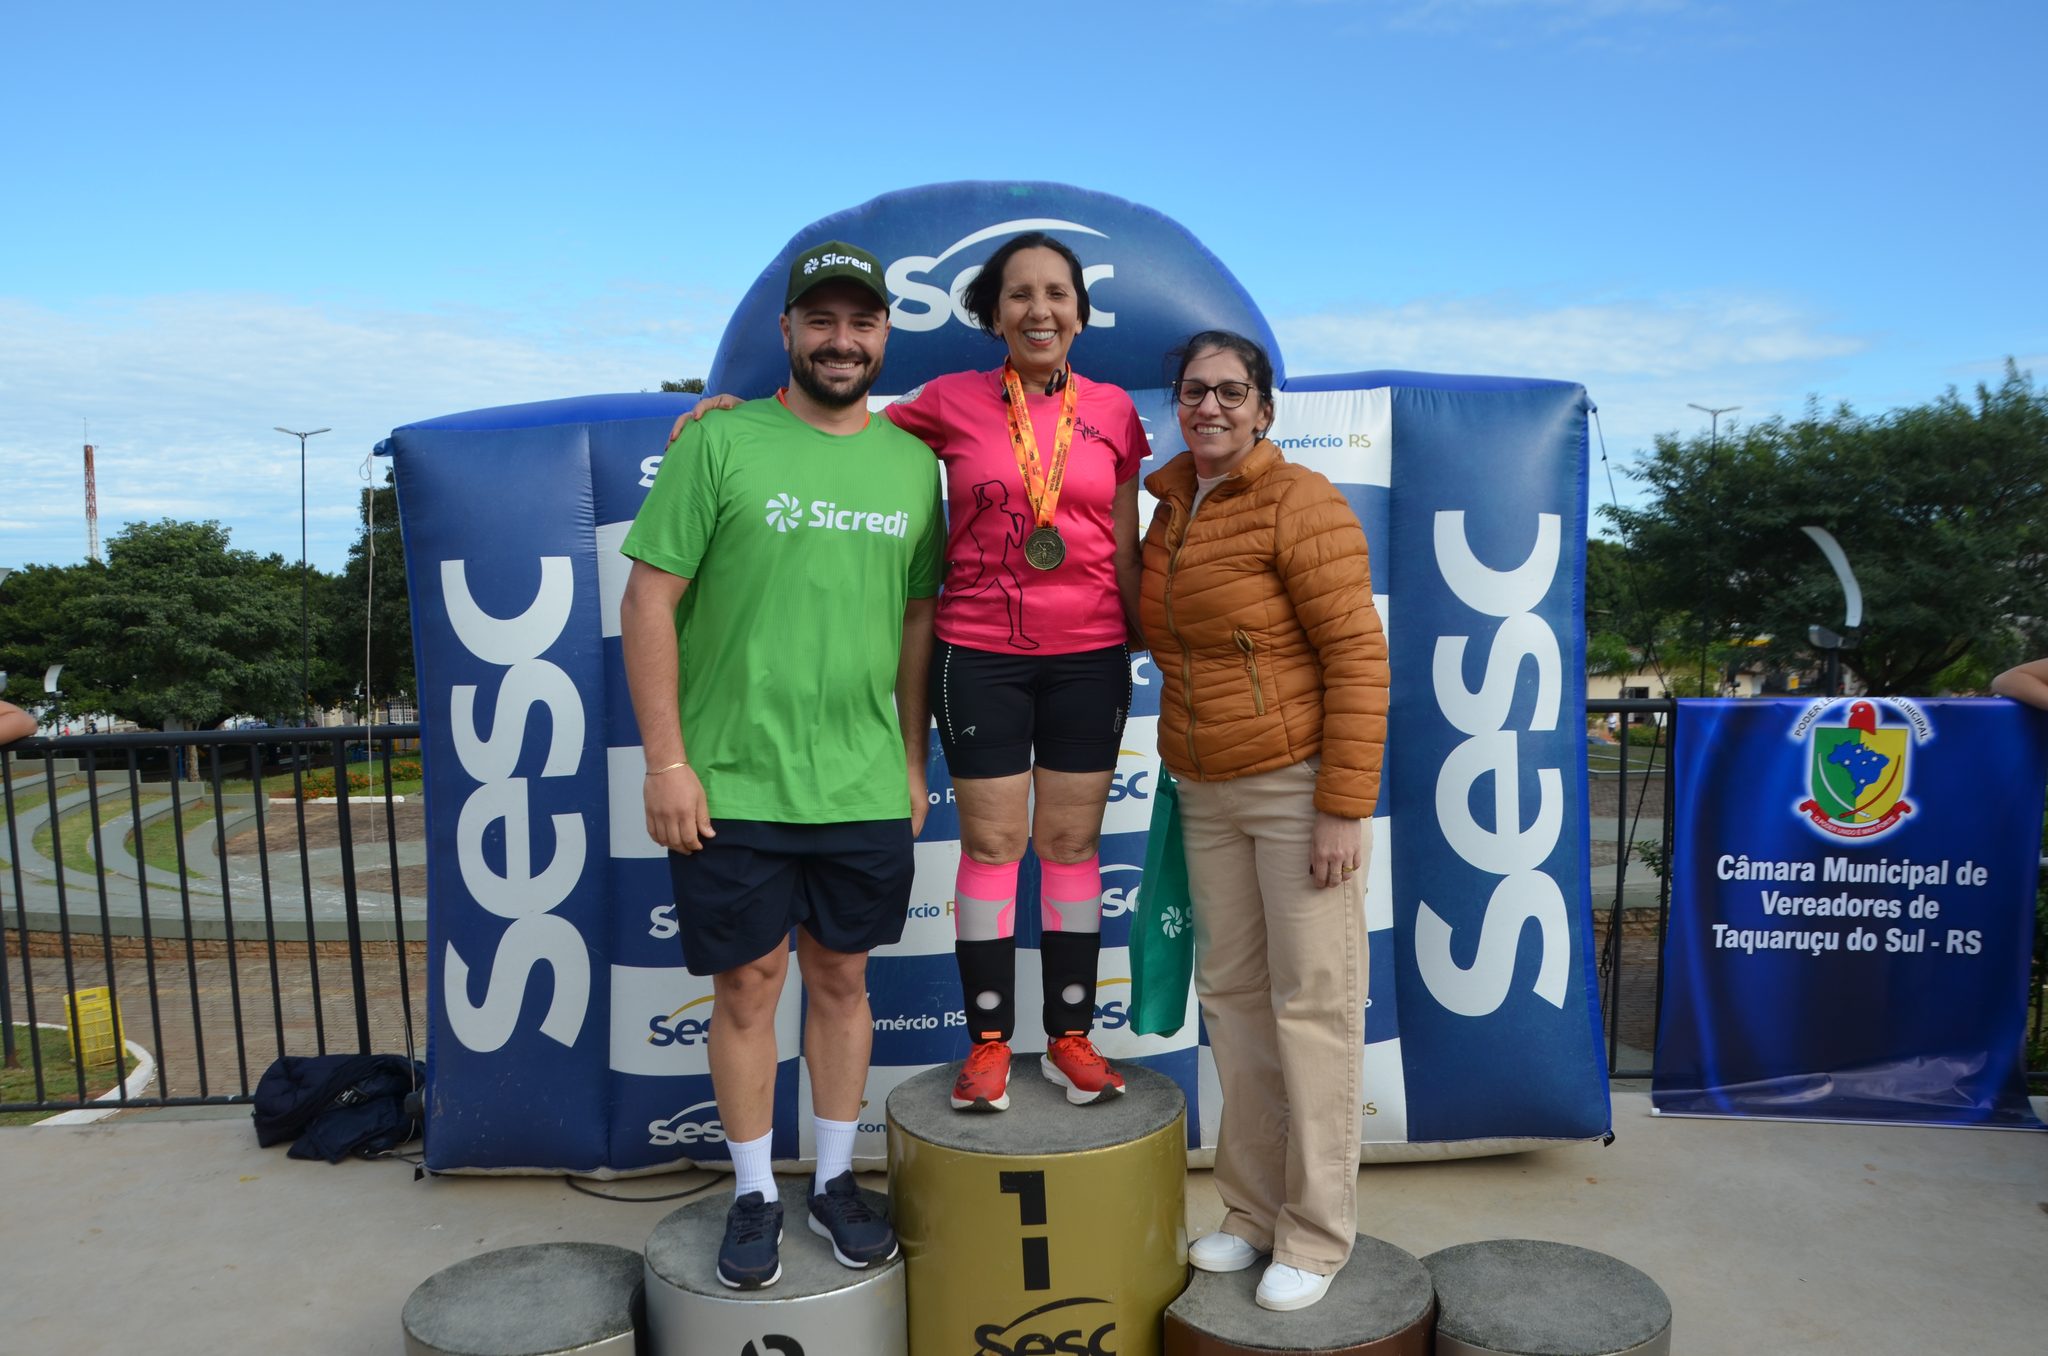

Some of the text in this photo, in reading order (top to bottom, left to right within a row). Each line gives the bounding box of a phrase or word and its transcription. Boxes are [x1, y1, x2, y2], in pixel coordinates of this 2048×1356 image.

[820, 252, 872, 274] Sicredi
[1271, 433, 1372, 449] omércio RS
[807, 500, 909, 539] Sicredi
[1794, 697, 1930, 741] PODER MUNICIPAL
[1716, 854, 1989, 890] Câmara Municipal de
[1760, 890, 1940, 920] Vereadores de
[1711, 924, 1983, 957] Taquaruçu do Sul - RS
[943, 1010, 967, 1028] RS
[999, 1170, 1051, 1291] 1
